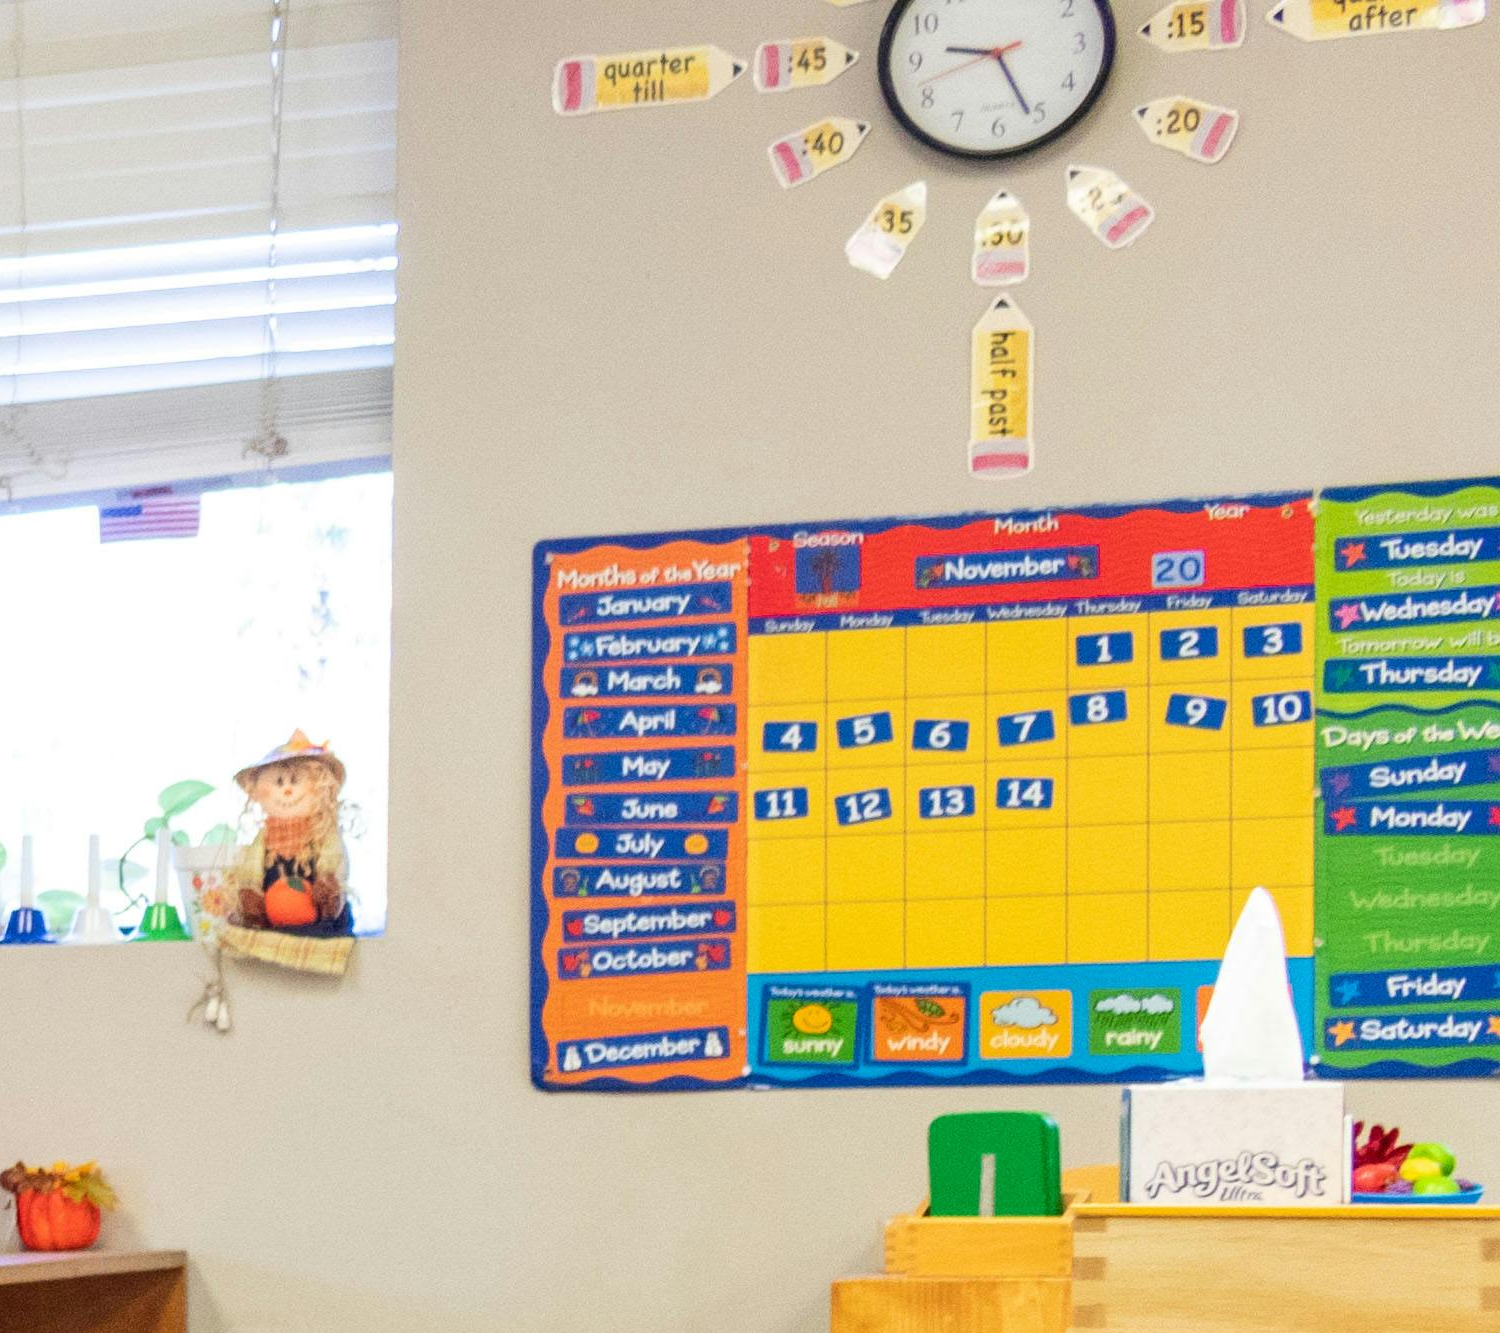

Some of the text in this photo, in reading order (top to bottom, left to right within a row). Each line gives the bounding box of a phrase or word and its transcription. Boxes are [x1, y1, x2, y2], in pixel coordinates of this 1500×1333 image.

[913, 12, 939, 36] 10
[1167, 13, 1205, 39] :15
[1349, 7, 1418, 32] after
[604, 53, 695, 88] quarter
[788, 47, 827, 73] :45
[633, 80, 665, 103] till
[991, 118, 1006, 138] 6
[1157, 108, 1200, 136] :20
[802, 131, 844, 157] :40
[980, 332, 1018, 438] half past
[993, 514, 1060, 535] Month
[1203, 502, 1251, 521] Year
[1357, 503, 1498, 527] Yesterday was
[793, 530, 864, 549] Season
[1380, 533, 1483, 560] Tuesday
[557, 559, 742, 590] Months of the Year
[943, 557, 1066, 583] November
[1155, 556, 1201, 584] 20
[1388, 568, 1466, 588] Today is
[596, 594, 691, 616] January
[764, 586, 1309, 635] Sunday Monday Tuesday Wednesday Thursday Friday Saturday
[1359, 592, 1495, 624] Wednesday
[595, 633, 701, 656] February
[1096, 628, 1284, 663] 1 2 3
[1338, 629, 1483, 656] Tomorrow will
[607, 668, 680, 690] March
[1358, 660, 1483, 688] Thursday
[619, 709, 676, 737] April
[780, 696, 1303, 748] 4 5 6 7 8 9 10
[1320, 723, 1455, 751] Days of the
[622, 755, 671, 780] May
[1369, 759, 1467, 789] Sunday
[621, 797, 678, 820] June
[765, 780, 1045, 821] 11 12 13 14
[1369, 805, 1472, 833] Monday
[615, 832, 665, 859] July
[1376, 844, 1480, 868] Tuesday
[595, 868, 682, 897] August
[583, 909, 712, 939] September
[1362, 930, 1492, 955] Thursday
[592, 947, 693, 972] October
[1386, 974, 1467, 1000] Friday
[588, 998, 710, 1017] November
[990, 1028, 1059, 1051] cloudy
[1105, 1028, 1164, 1053] rainy
[1360, 1016, 1484, 1042] Saturday
[583, 1036, 701, 1065] December
[782, 1036, 843, 1058] sunny
[887, 1032, 949, 1057] windy
